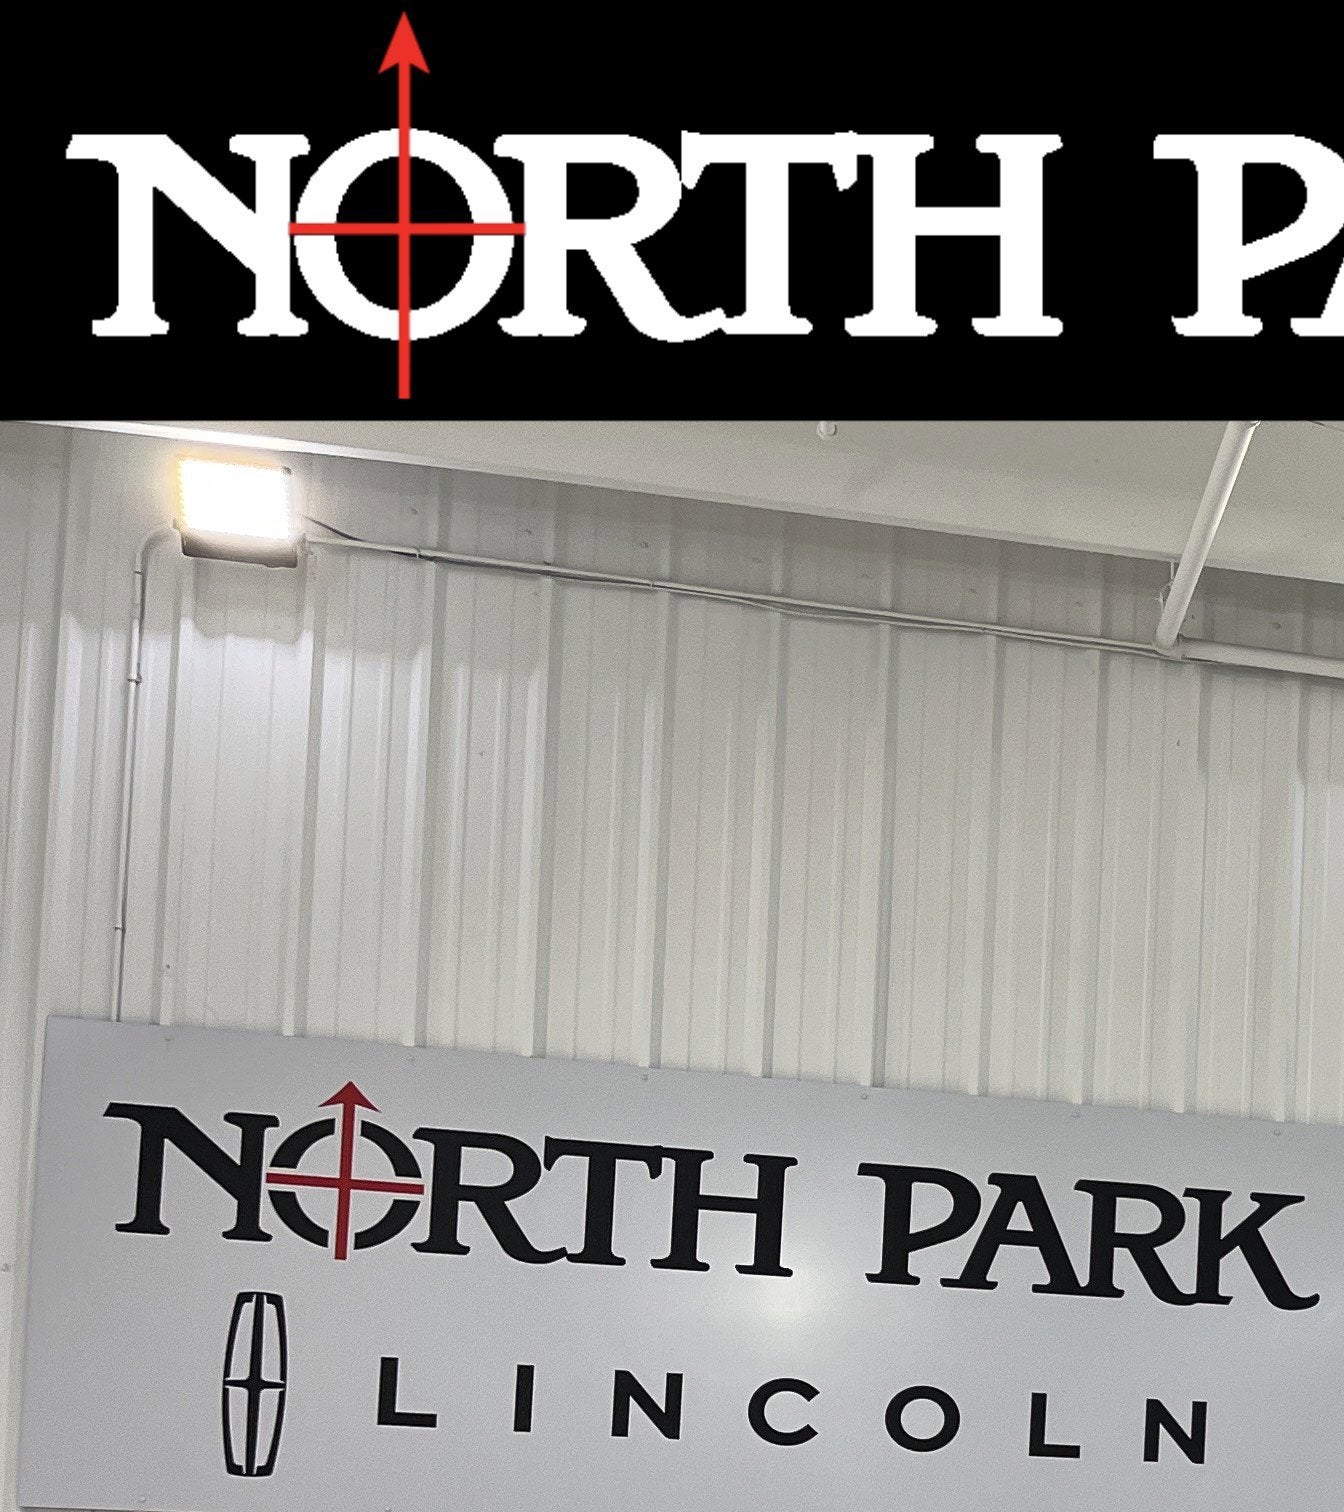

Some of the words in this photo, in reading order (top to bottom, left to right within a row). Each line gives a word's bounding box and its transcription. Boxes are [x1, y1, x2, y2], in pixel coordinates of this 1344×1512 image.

[103, 1102, 798, 1278] NORTH
[858, 1163, 1320, 1310] PARK
[378, 1356, 1208, 1465] LINCOLN
